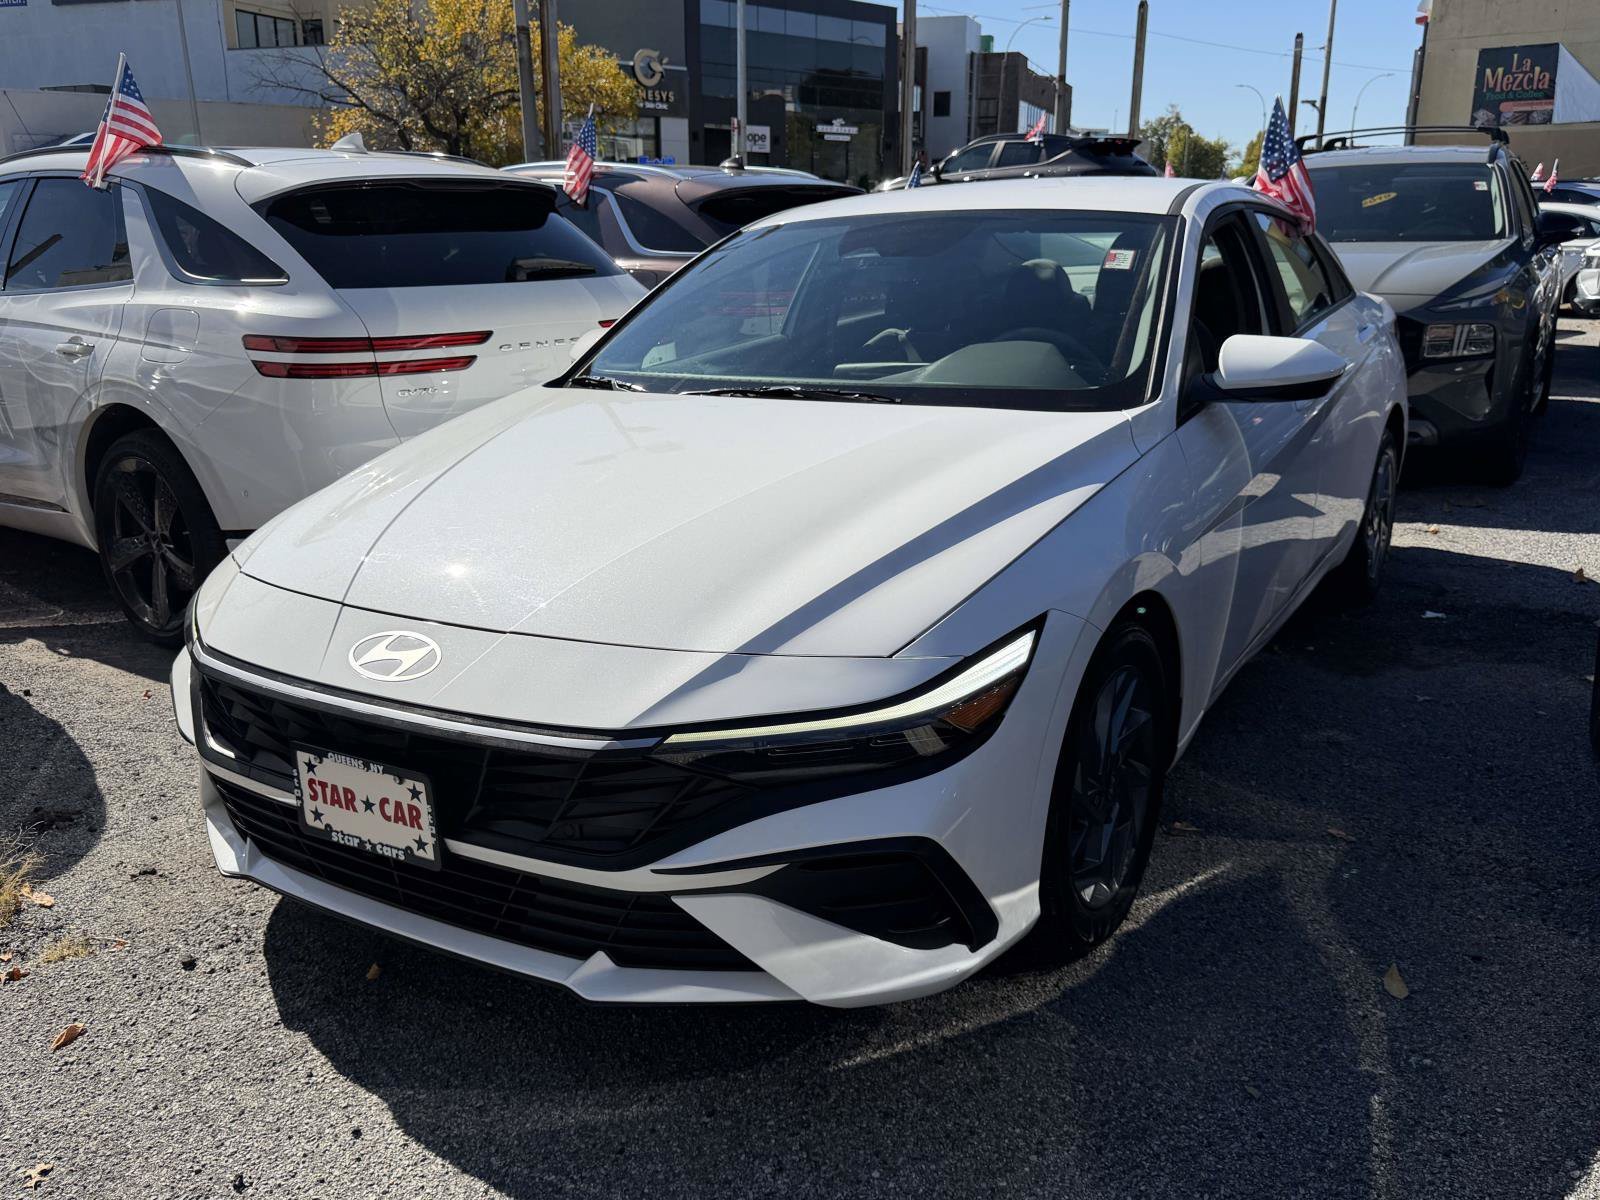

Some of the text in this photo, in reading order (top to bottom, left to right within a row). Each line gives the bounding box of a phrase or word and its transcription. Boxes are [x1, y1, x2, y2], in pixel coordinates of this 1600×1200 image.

[1512, 53, 1531, 72] La
[1484, 67, 1550, 92] Mezcla
[633, 88, 675, 102] NESYS
[747, 133, 767, 145] ope
[499, 336, 580, 352] GENES
[328, 752, 384, 775] QUEENS, NY
[307, 777, 424, 831] STAR CAR
[331, 830, 406, 861] star cars
